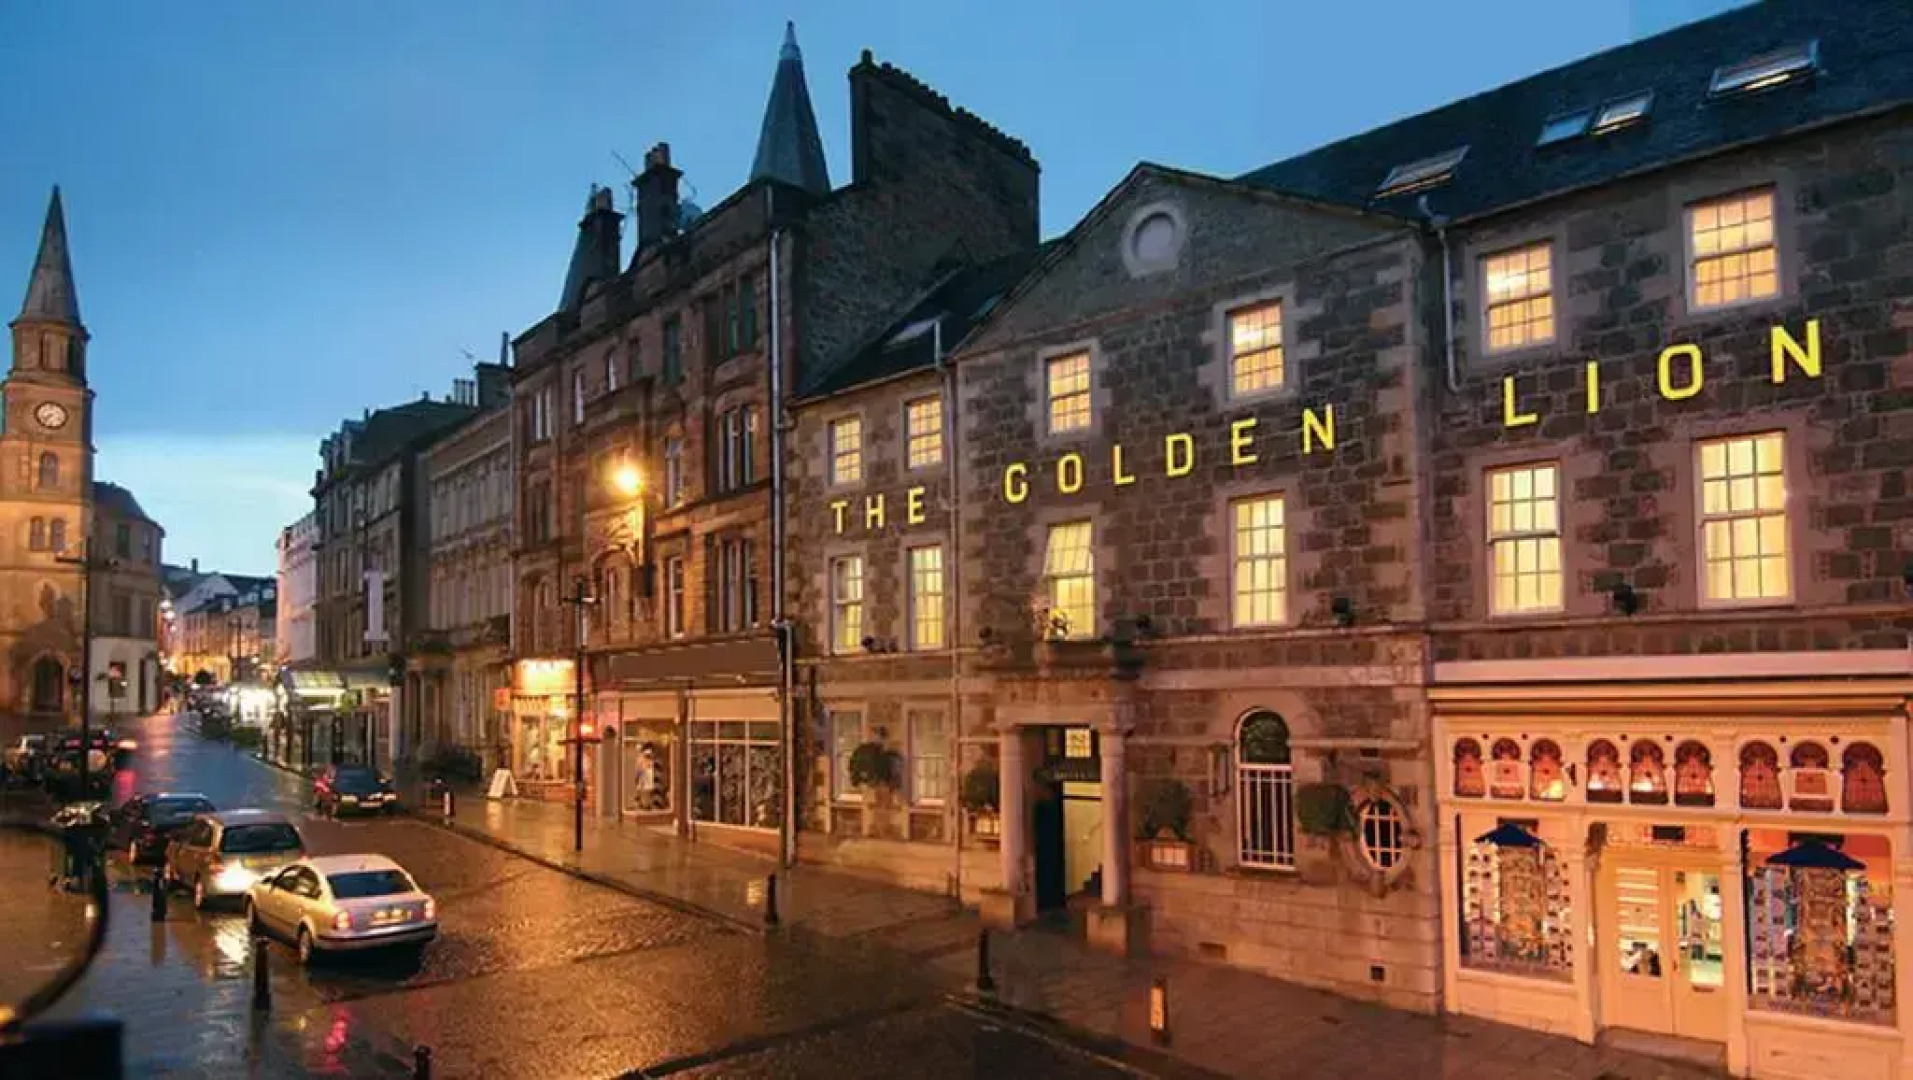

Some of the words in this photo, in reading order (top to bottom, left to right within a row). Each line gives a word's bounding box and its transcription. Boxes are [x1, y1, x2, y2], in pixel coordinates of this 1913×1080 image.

[831, 486, 926, 534] THE
[1004, 403, 1338, 505] GOLDEN
[1503, 319, 1823, 427] LION
